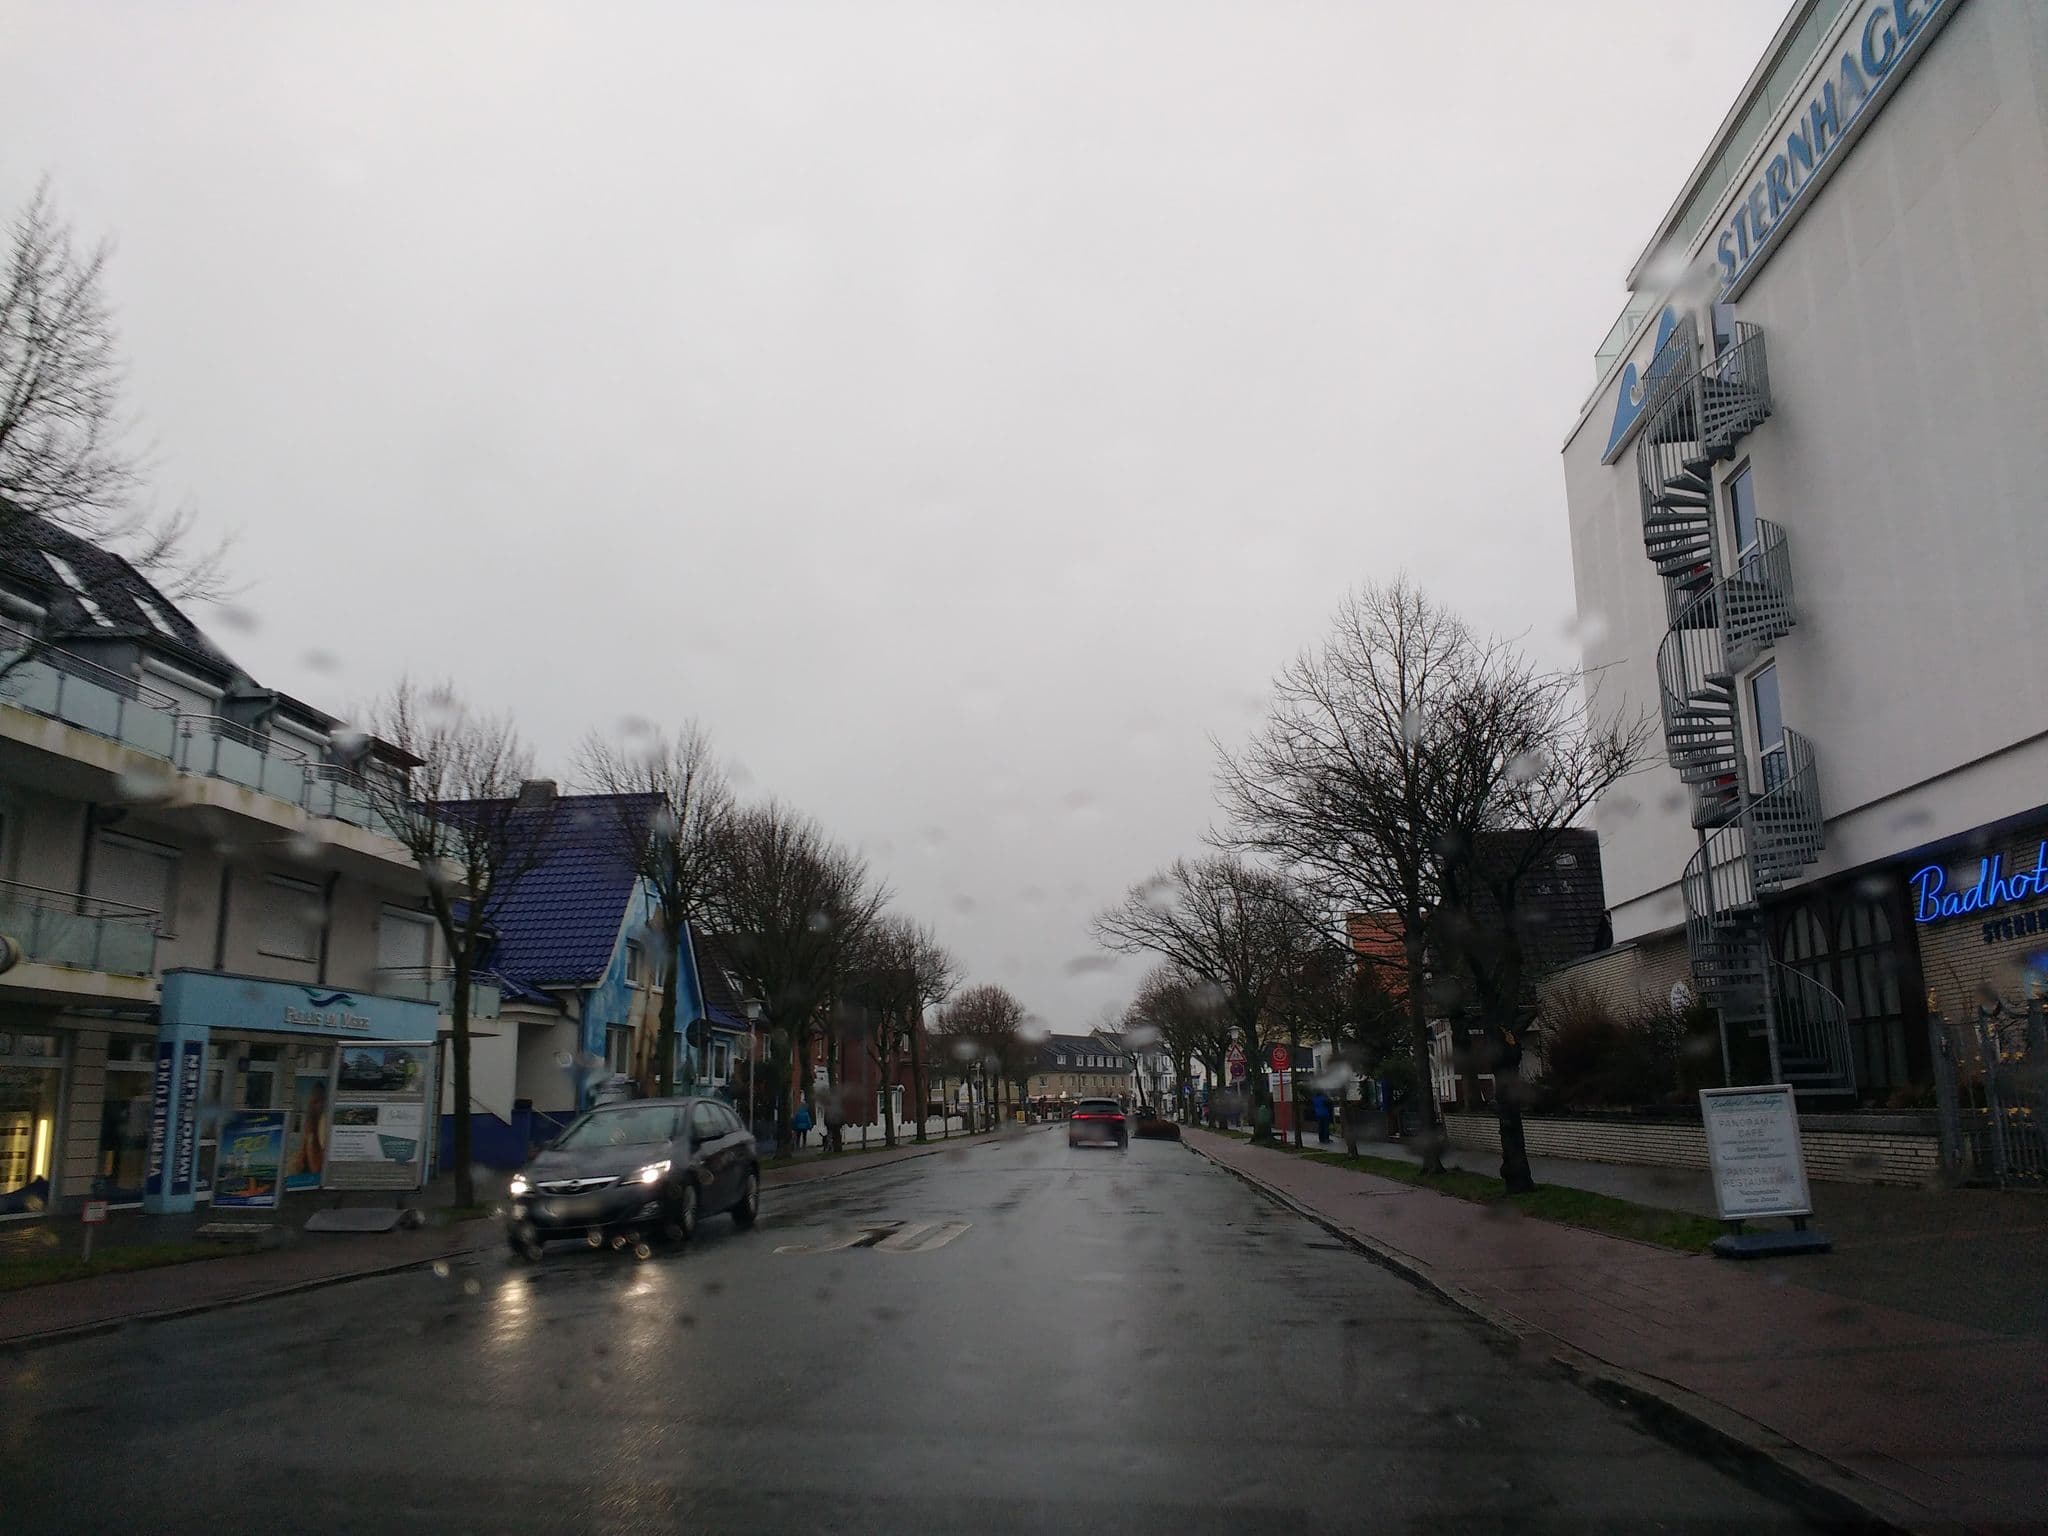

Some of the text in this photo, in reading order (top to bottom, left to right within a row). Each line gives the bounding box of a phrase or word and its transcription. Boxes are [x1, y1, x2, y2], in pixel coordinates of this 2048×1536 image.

[1716, 0, 1928, 286] STERNHAGE
[148, 1057, 172, 1177] VERMIETUNG
[178, 1054, 201, 1184] IMMOBILIEN
[1718, 1118, 1776, 1129] PANORAMA
